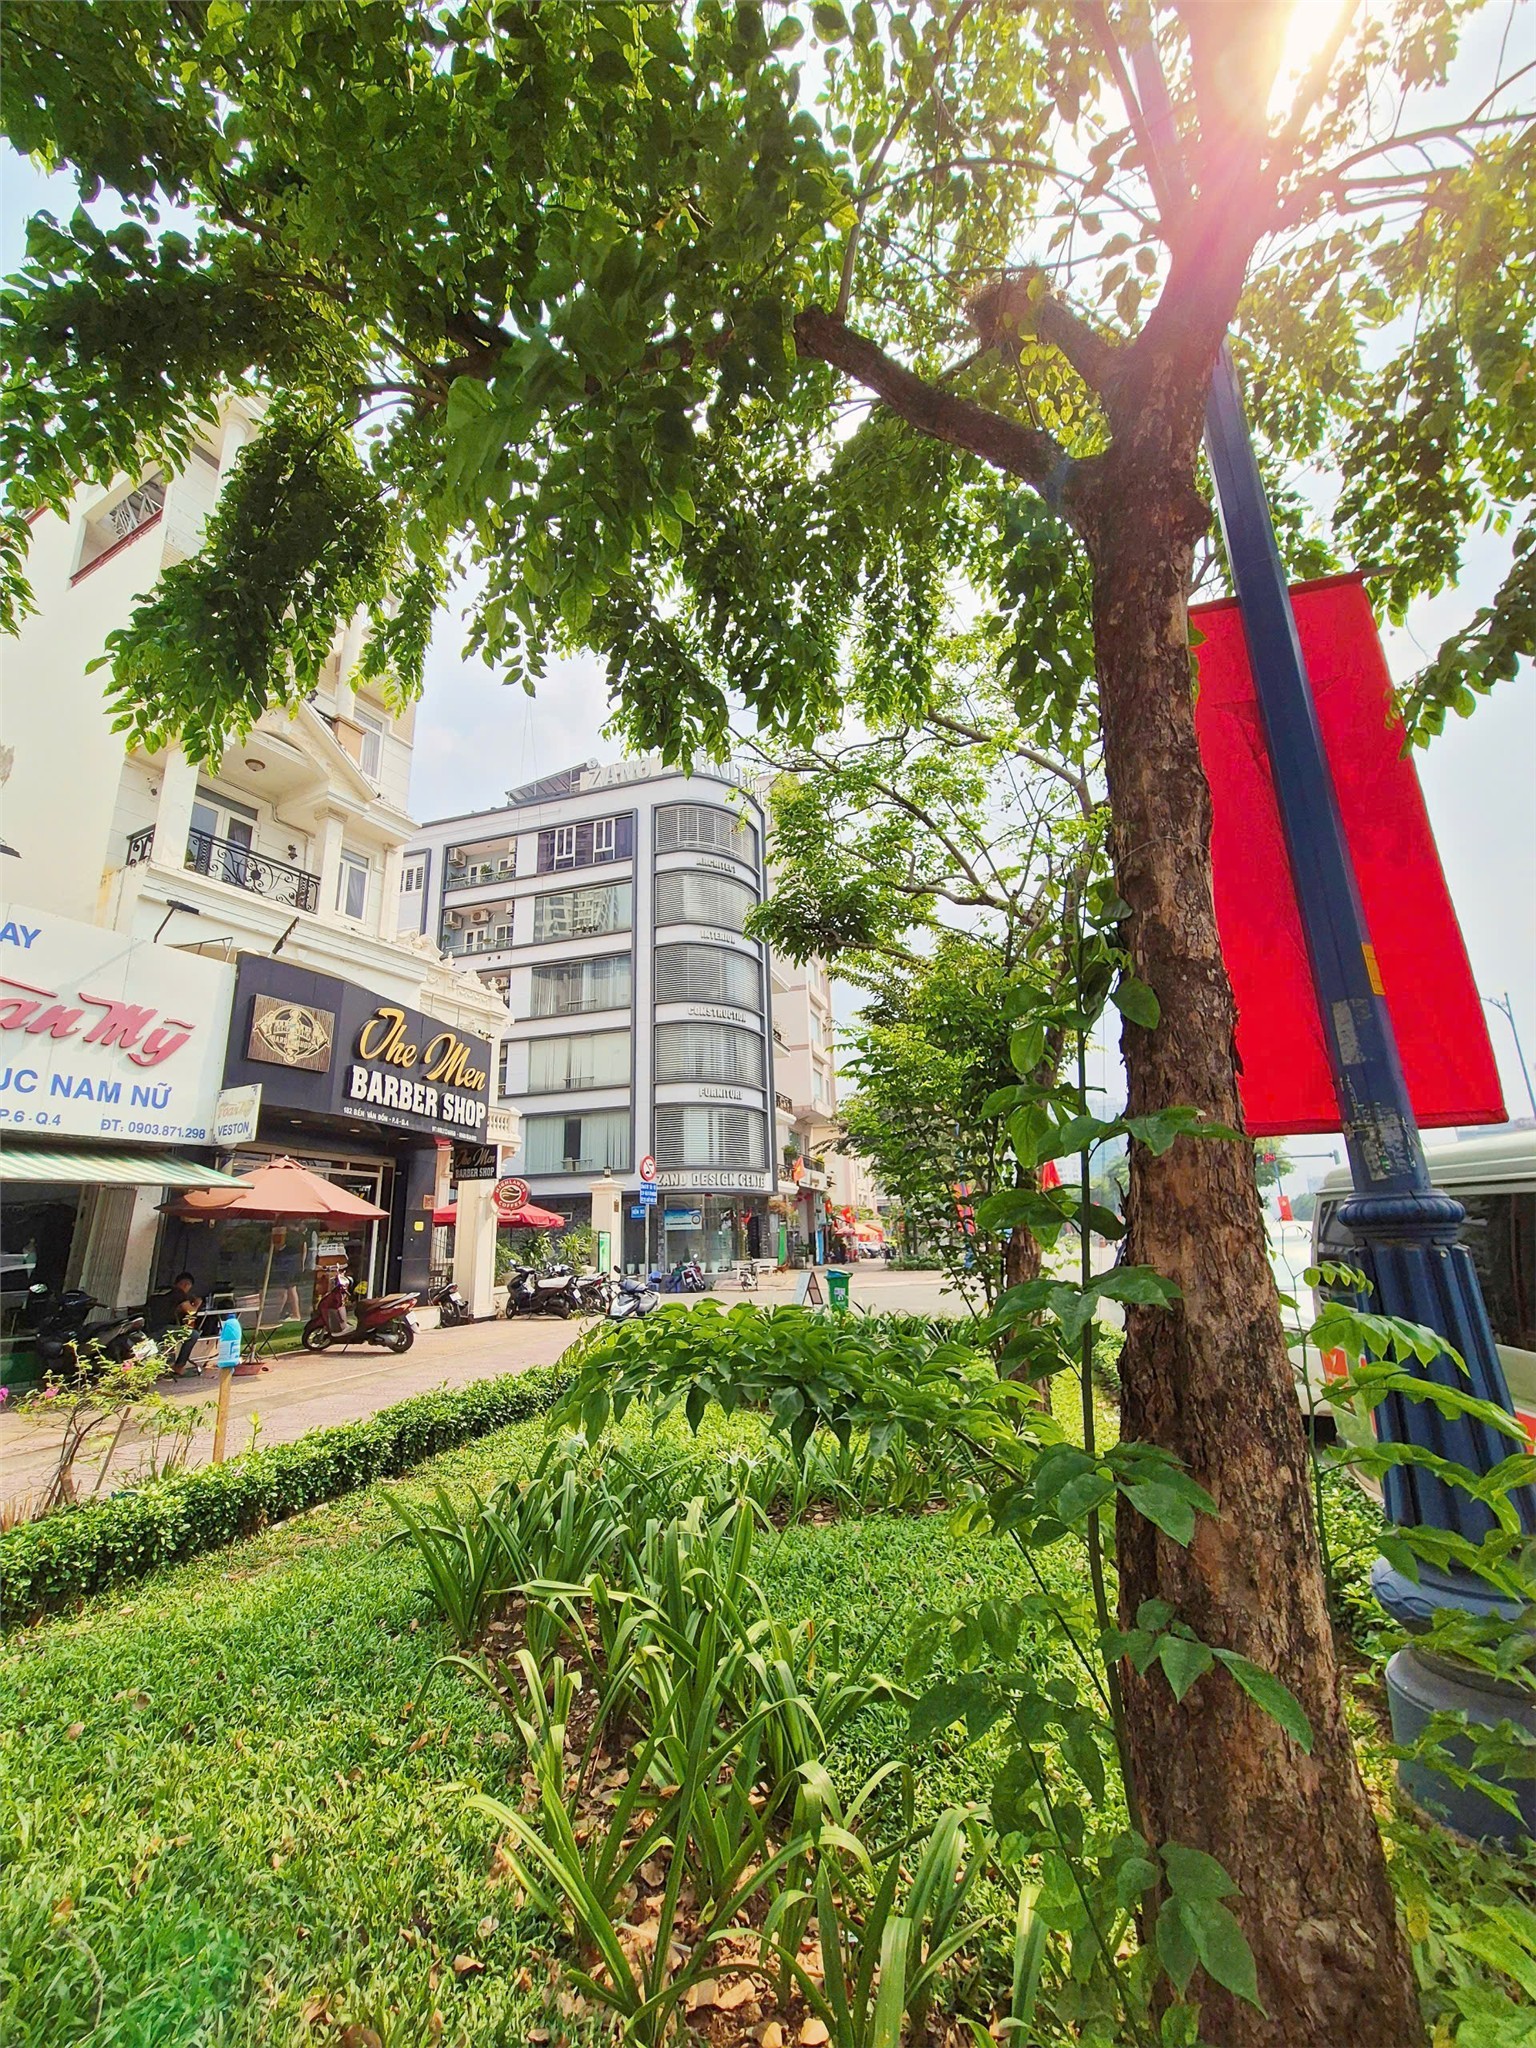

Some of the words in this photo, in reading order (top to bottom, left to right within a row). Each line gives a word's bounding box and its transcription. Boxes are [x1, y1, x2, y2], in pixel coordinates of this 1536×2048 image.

[359, 1006, 417, 1068] The
[424, 1032, 486, 1091] Men
[50, 1073, 122, 1104] NAM
[130, 1082, 173, 1110] NỮ
[350, 1064, 438, 1118] BARBER
[442, 1092, 486, 1128] SHOP
[127, 1121, 206, 1140] 0903.871.298
[217, 1121, 250, 1137] VESTON
[472, 1146, 496, 1167] Men
[455, 1167, 479, 1179] BARBER
[479, 1166, 495, 1177] SHOP
[692, 1172, 734, 1187] DESIGN
[494, 1178, 527, 1194] HIGHLANDS
[497, 1199, 523, 1210] COFFEE
